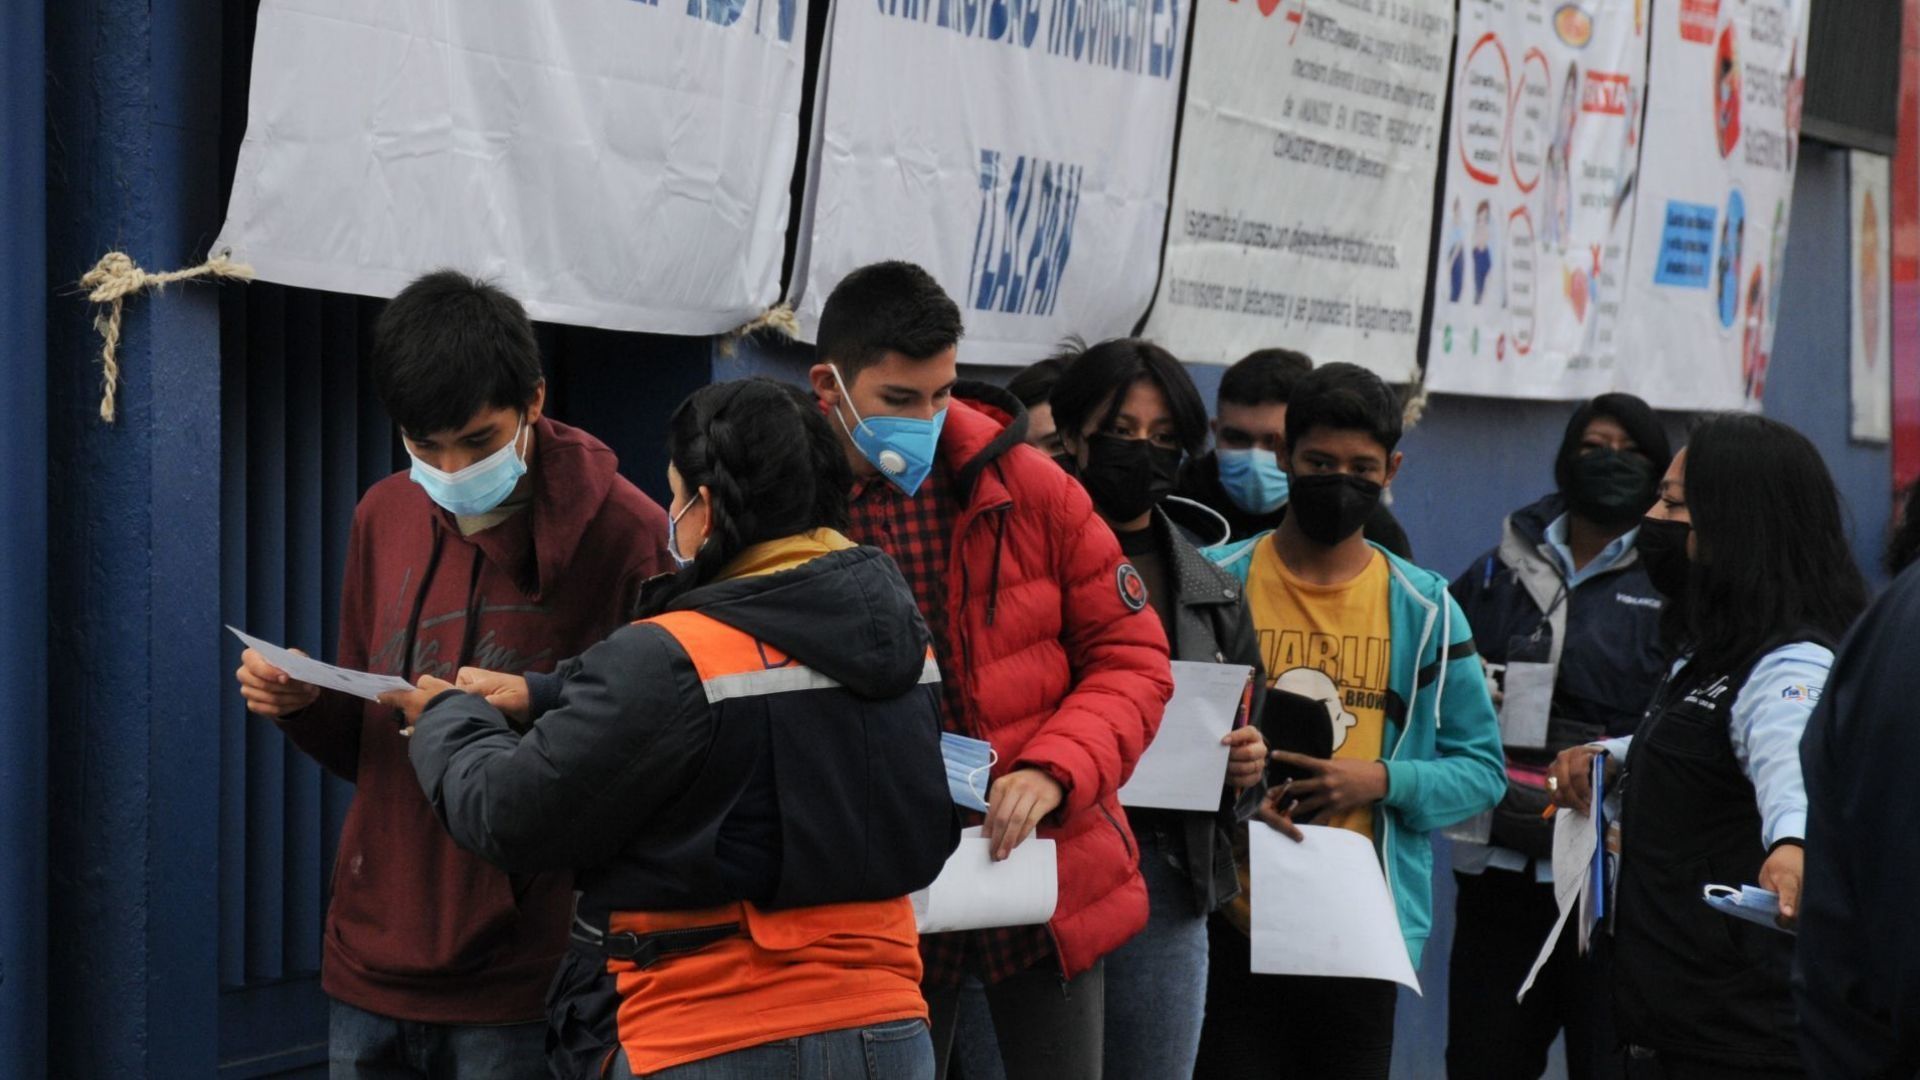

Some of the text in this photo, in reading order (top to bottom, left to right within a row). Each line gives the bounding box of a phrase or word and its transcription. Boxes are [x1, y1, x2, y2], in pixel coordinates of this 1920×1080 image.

[967, 149, 1083, 316] TLALPAN
[1255, 628, 1391, 692] HARLI
[1345, 690, 1386, 710] BROW
